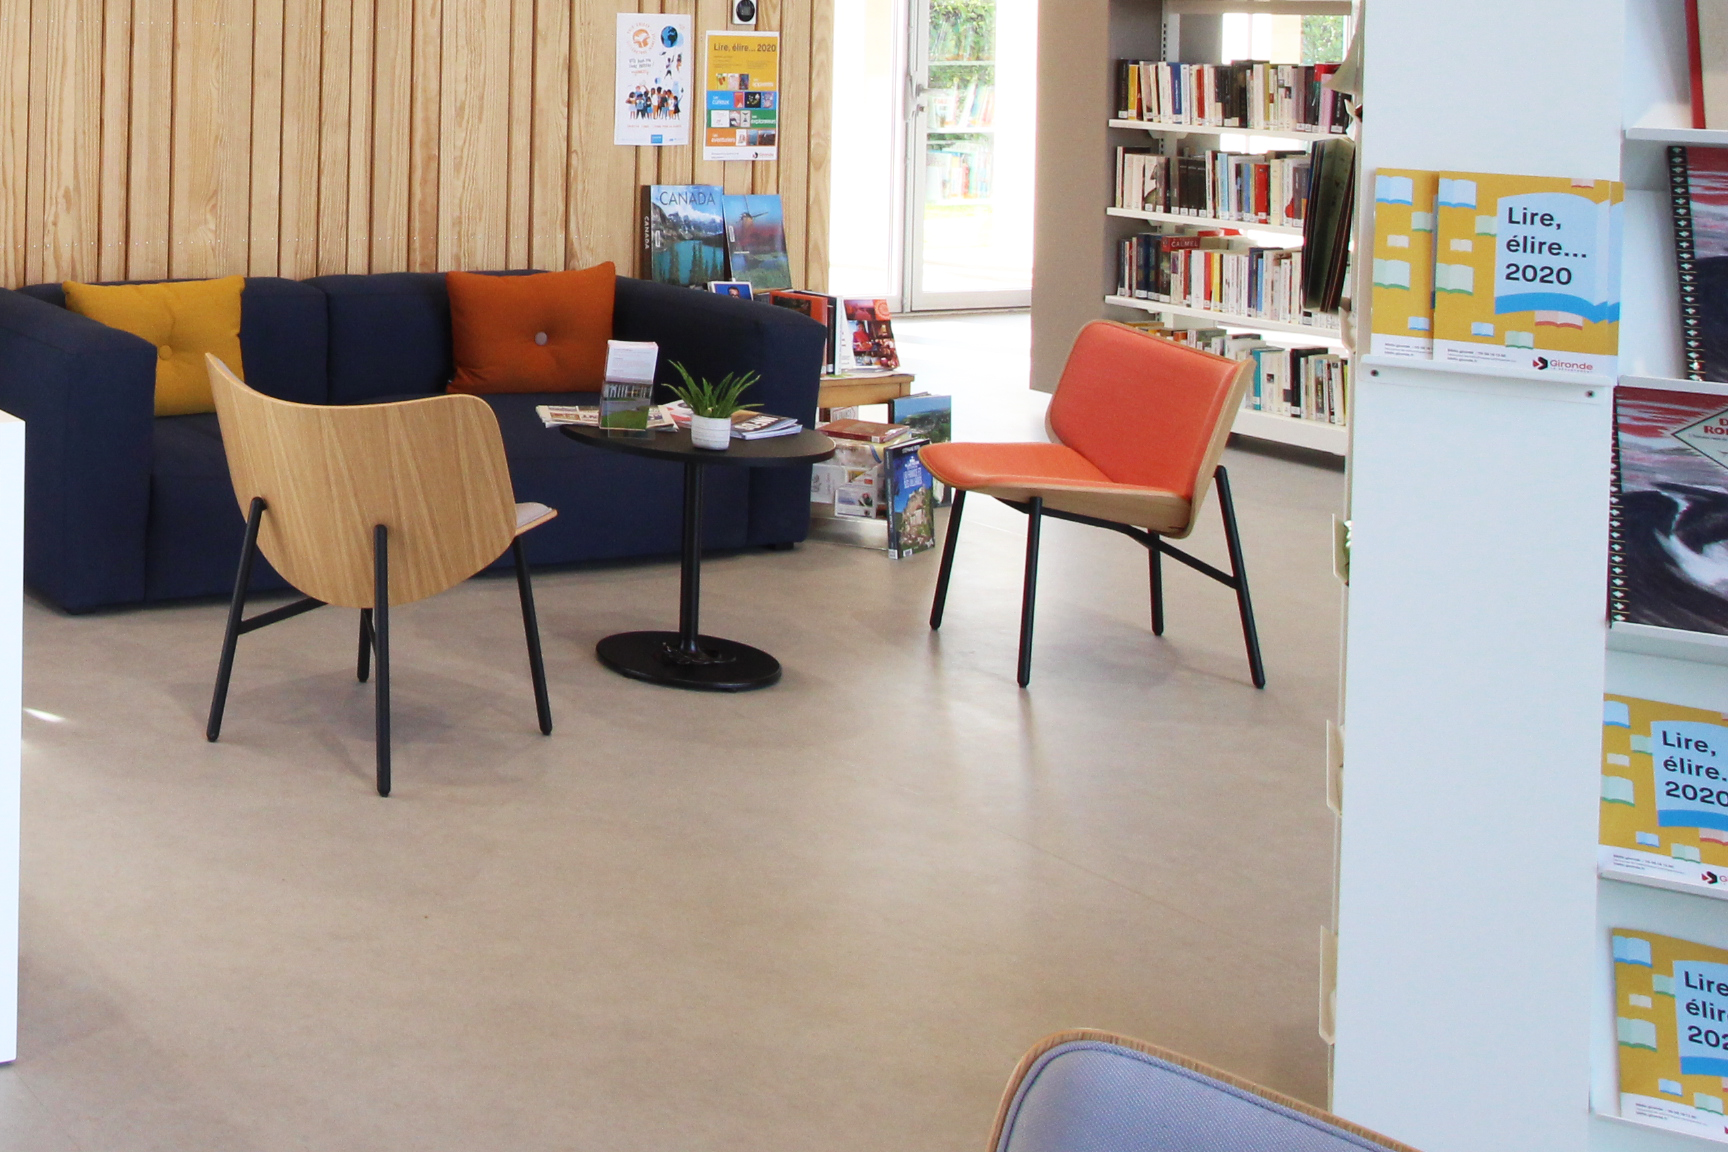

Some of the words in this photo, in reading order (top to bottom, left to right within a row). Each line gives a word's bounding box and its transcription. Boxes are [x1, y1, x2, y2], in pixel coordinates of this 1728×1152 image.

[714, 43, 730, 52] Lire,
[757, 44, 776, 52] 2020
[660, 191, 715, 206] CANADA
[1508, 207, 1561, 230] Lire,
[1171, 239, 1198, 248] CALMEL
[1506, 235, 1586, 258] élire...
[1505, 263, 1572, 285] 2020
[1550, 360, 1593, 371] Gironde
[1662, 730, 1716, 756] Lire,
[1665, 781, 1728, 807] 2020
